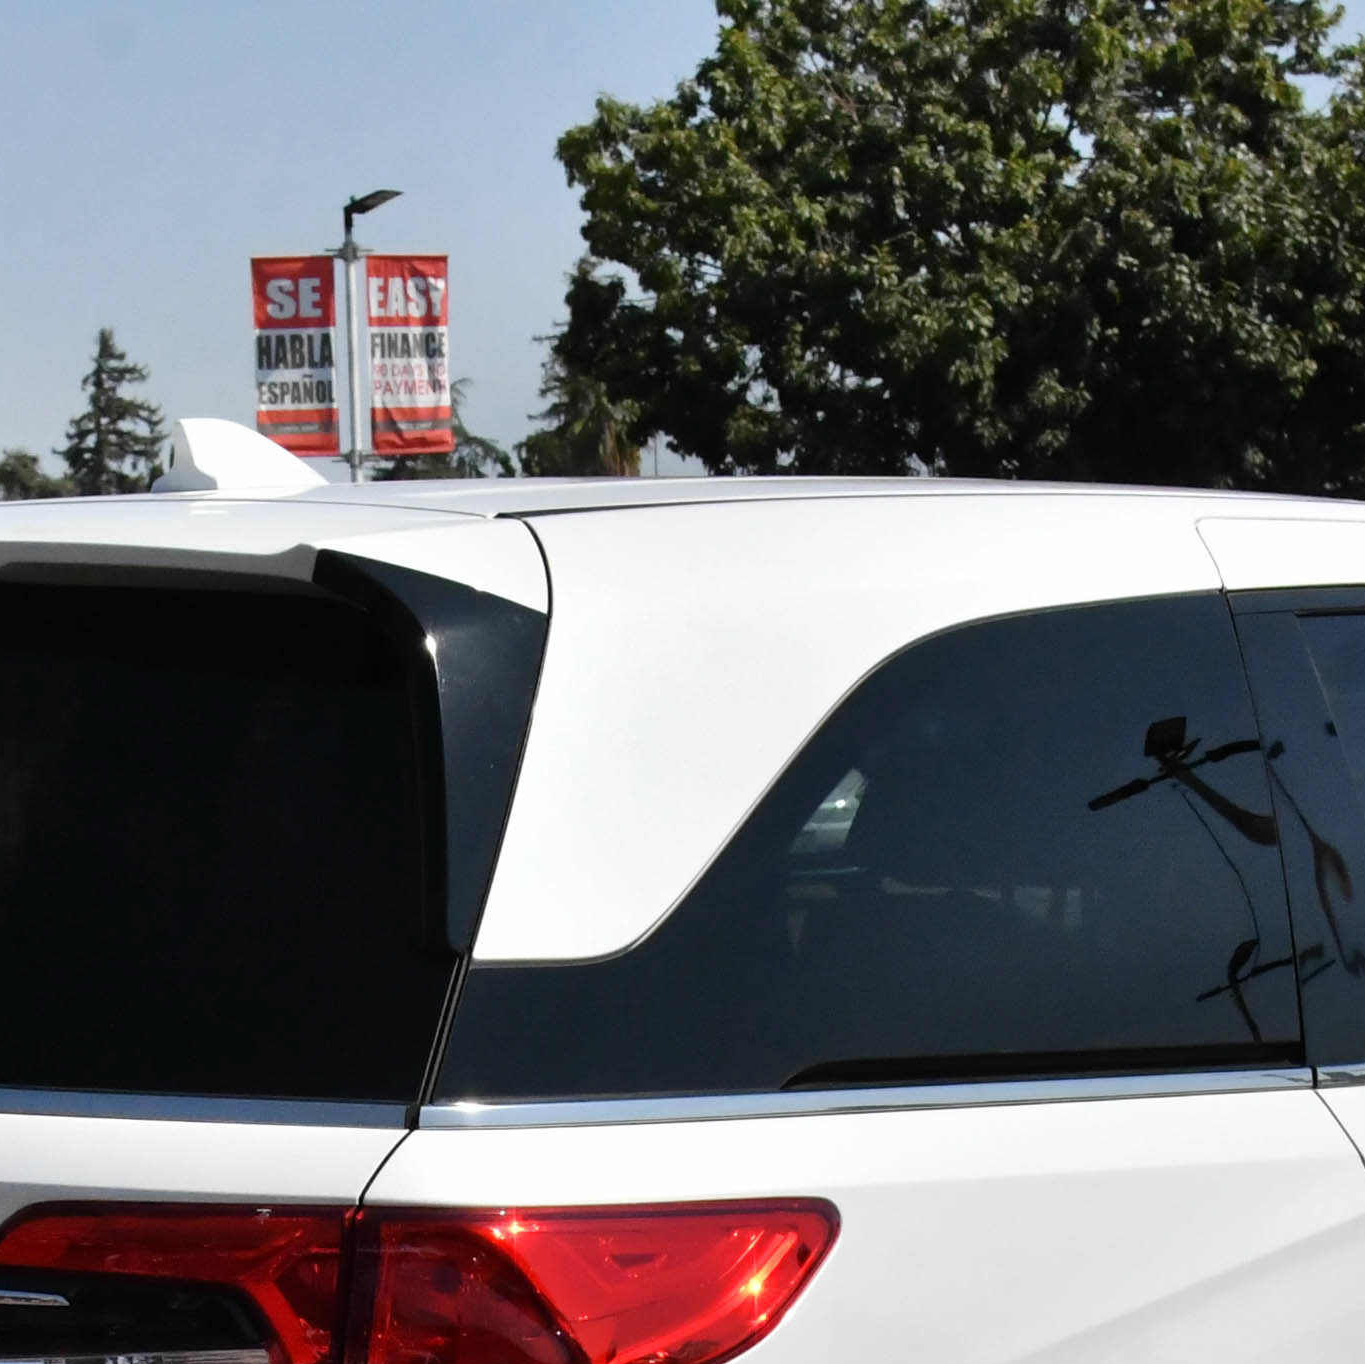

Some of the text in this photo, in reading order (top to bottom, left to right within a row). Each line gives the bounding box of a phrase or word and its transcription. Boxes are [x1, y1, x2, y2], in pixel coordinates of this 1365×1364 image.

[266, 278, 323, 319] SE
[368, 277, 446, 317] EASY
[256, 333, 334, 370] HABLA
[371, 332, 446, 359] FINANCE
[258, 374, 335, 405] ESPAÑOL
